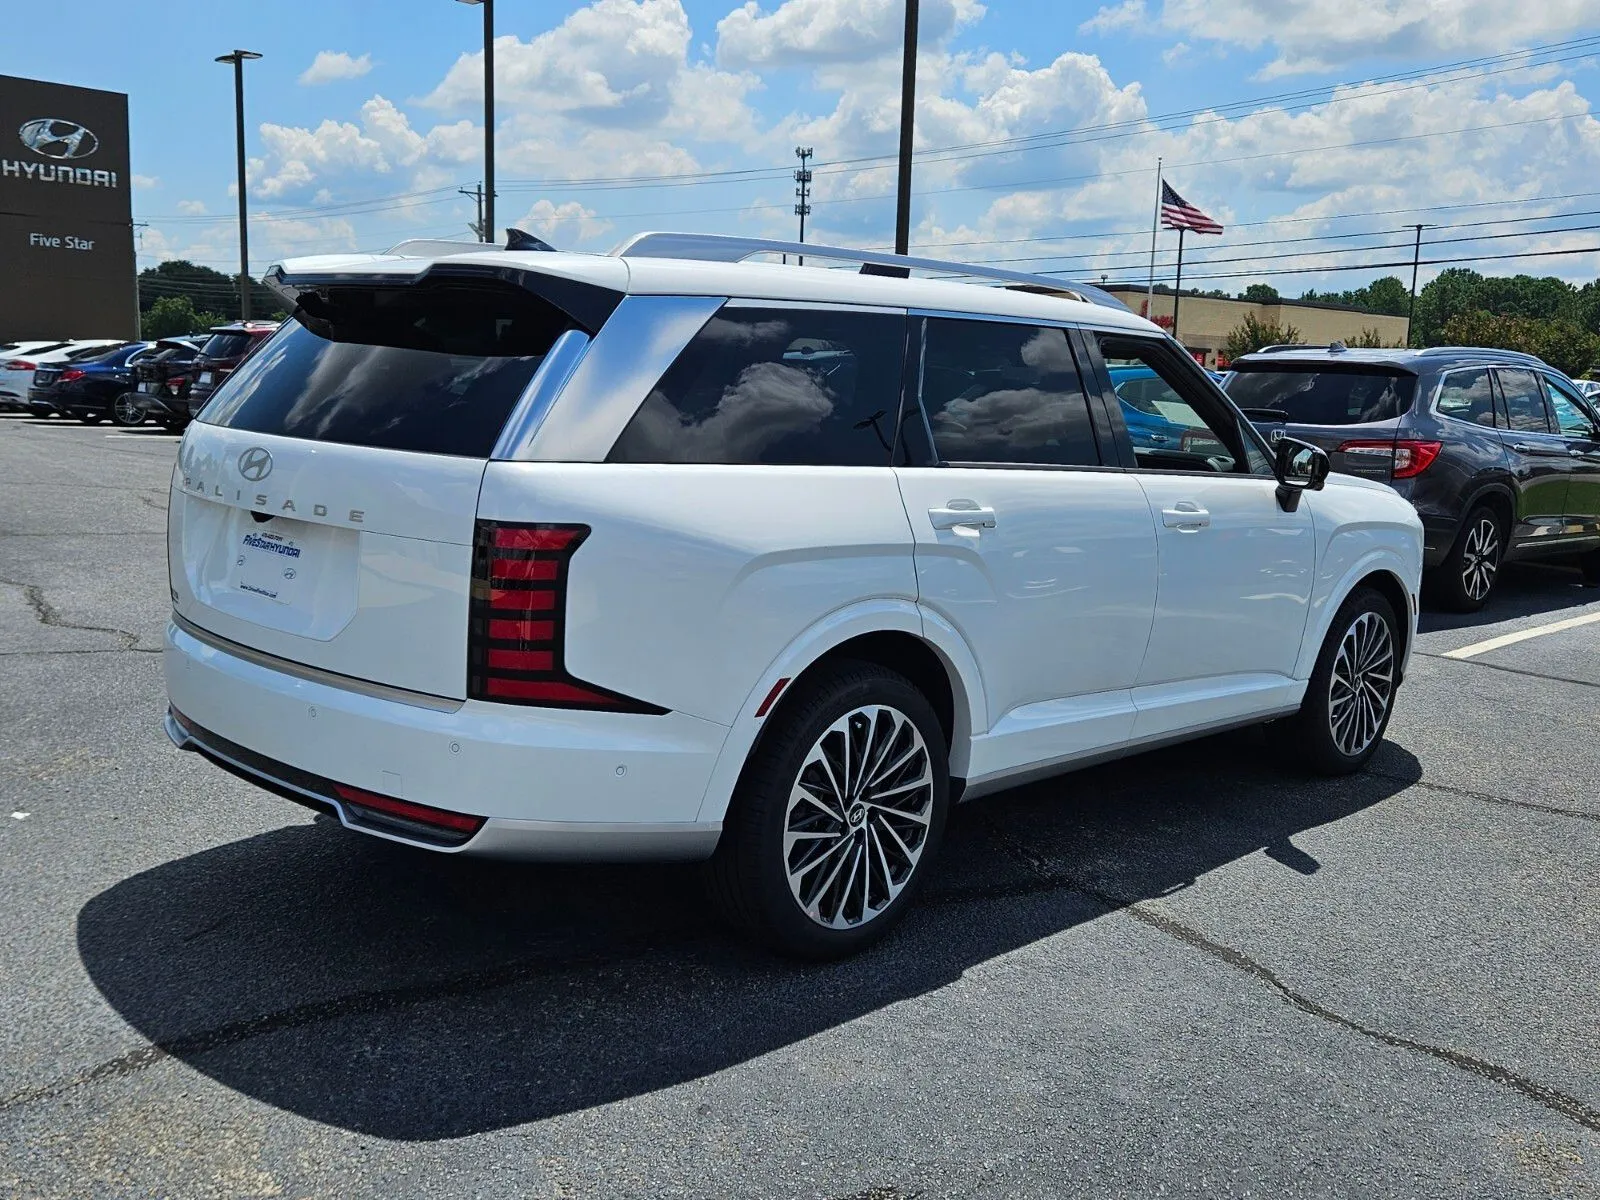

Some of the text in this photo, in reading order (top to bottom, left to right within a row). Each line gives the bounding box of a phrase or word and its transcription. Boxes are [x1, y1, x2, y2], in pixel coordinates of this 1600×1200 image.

[2, 159, 117, 188] HYUNDAI
[29, 232, 95, 250] Five Star
[184, 477, 365, 523] PALISADE
